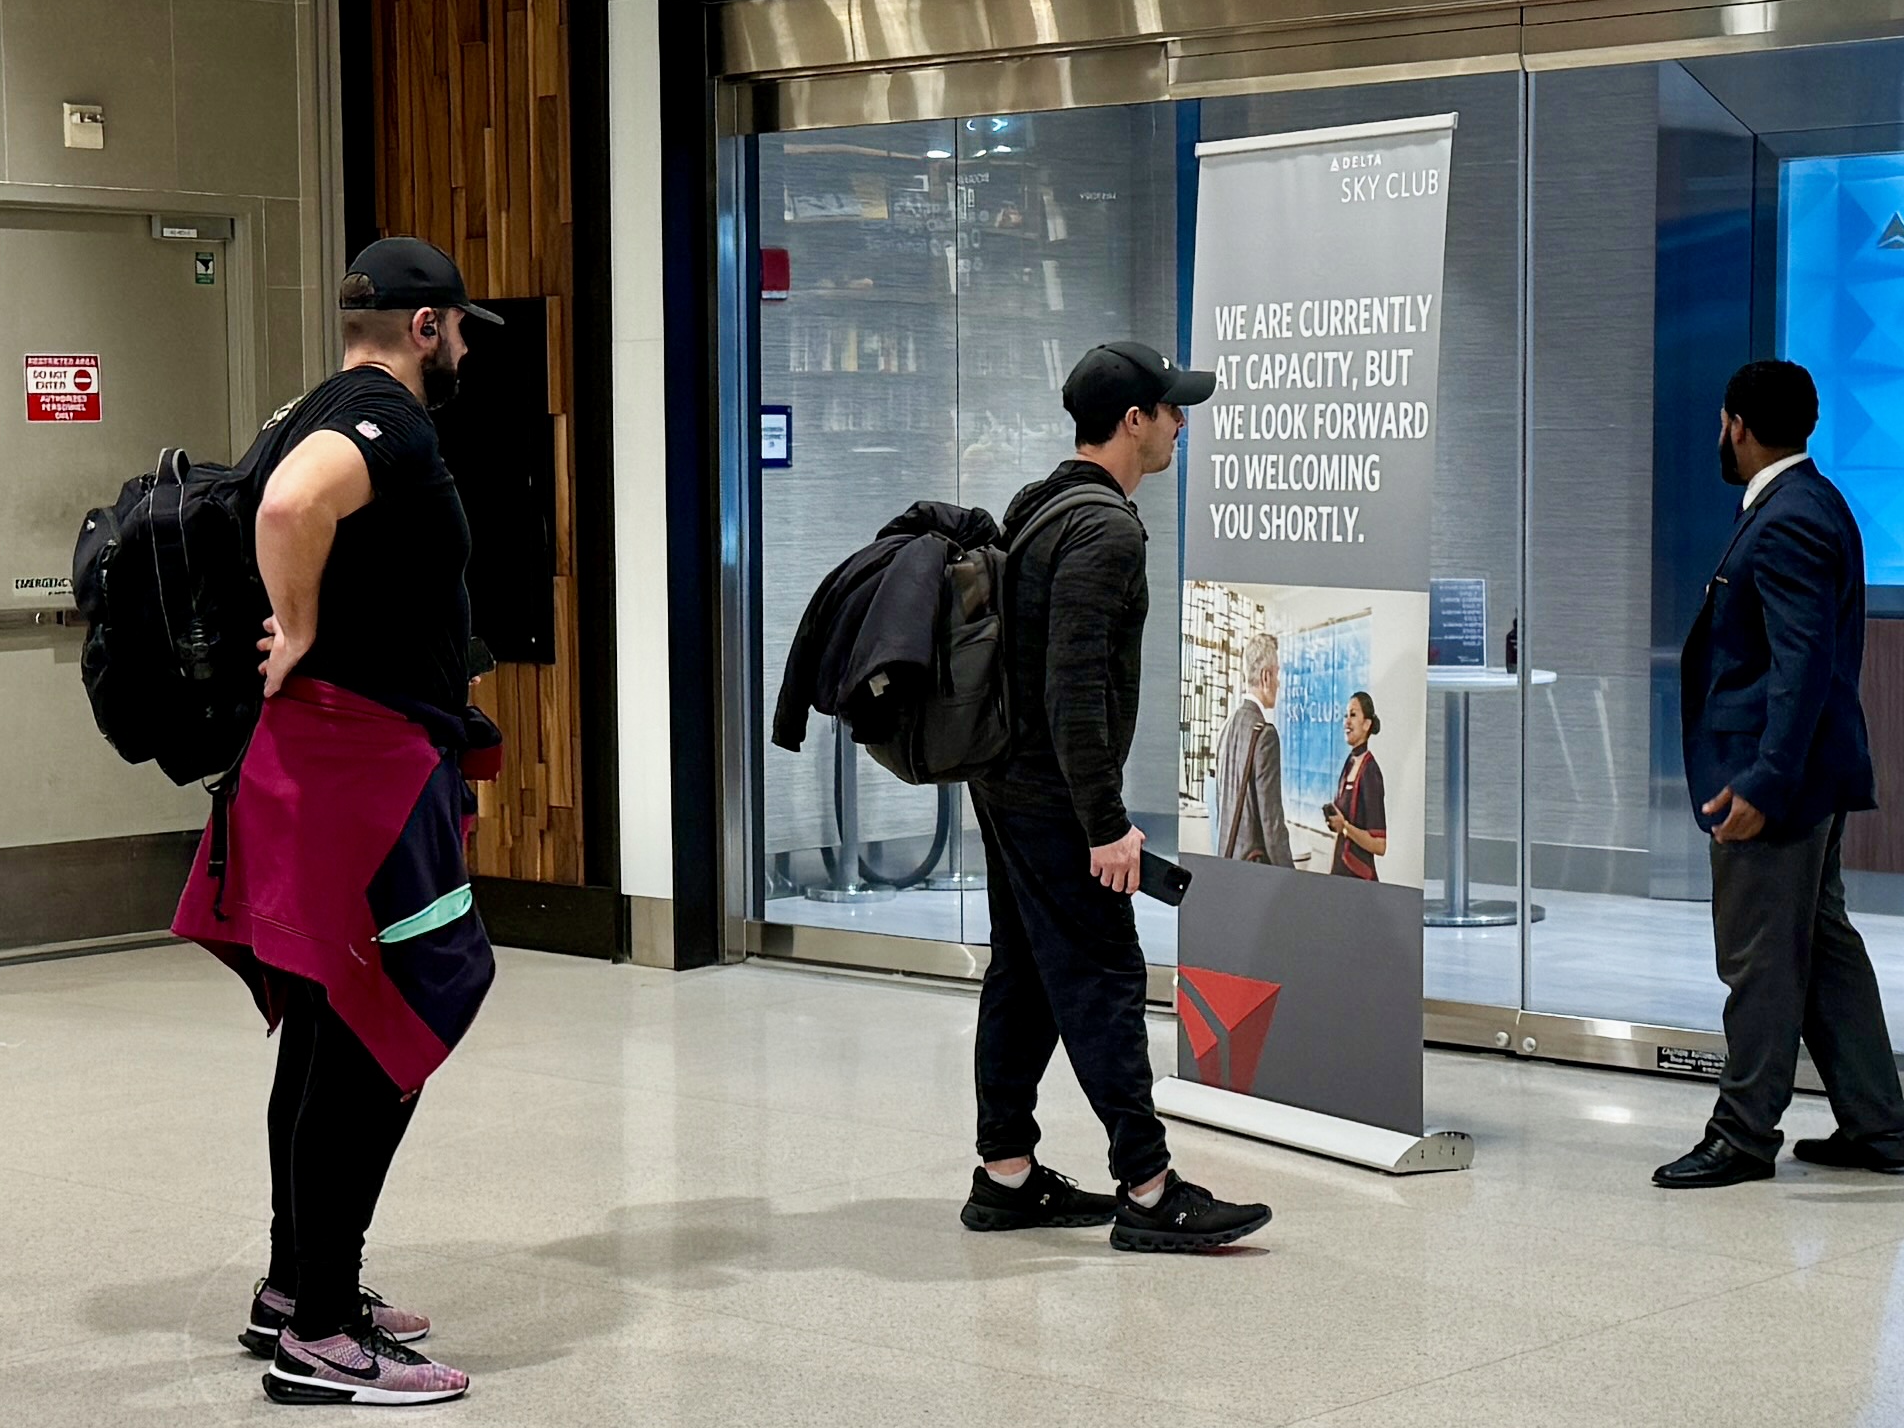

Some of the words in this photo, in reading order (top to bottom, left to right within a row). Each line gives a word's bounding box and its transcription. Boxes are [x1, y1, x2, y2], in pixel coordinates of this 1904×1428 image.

[1343, 153, 1382, 169] DELTA
[1341, 174, 1381, 203] SKY
[1386, 169, 1440, 199] CLUB
[1215, 305, 1247, 341] WE
[1252, 302, 1293, 339] ARE
[1299, 294, 1433, 337] CURRENTLY
[75, 358, 96, 366] AREA
[1216, 355, 1238, 390] AT
[1245, 351, 1358, 392] CAPACITY,
[1365, 349, 1413, 386] BUT
[33, 371, 46, 379] DO
[49, 371, 67, 379] NOT
[36, 381, 66, 389] ENTER
[40, 395, 87, 403] AUTHORIZED
[41, 404, 86, 412] PERSONNEL
[1213, 404, 1244, 440] WE
[1250, 403, 1307, 439] LOOK
[1314, 402, 1429, 438] FORWARD
[1211, 454, 1239, 489] TO
[1244, 454, 1381, 491] WELCOMING
[1210, 504, 1253, 540] YOU
[1259, 505, 1365, 542] SHORTLY.
[1287, 703, 1305, 723] SKY
[1310, 701, 1341, 723] CLUB
